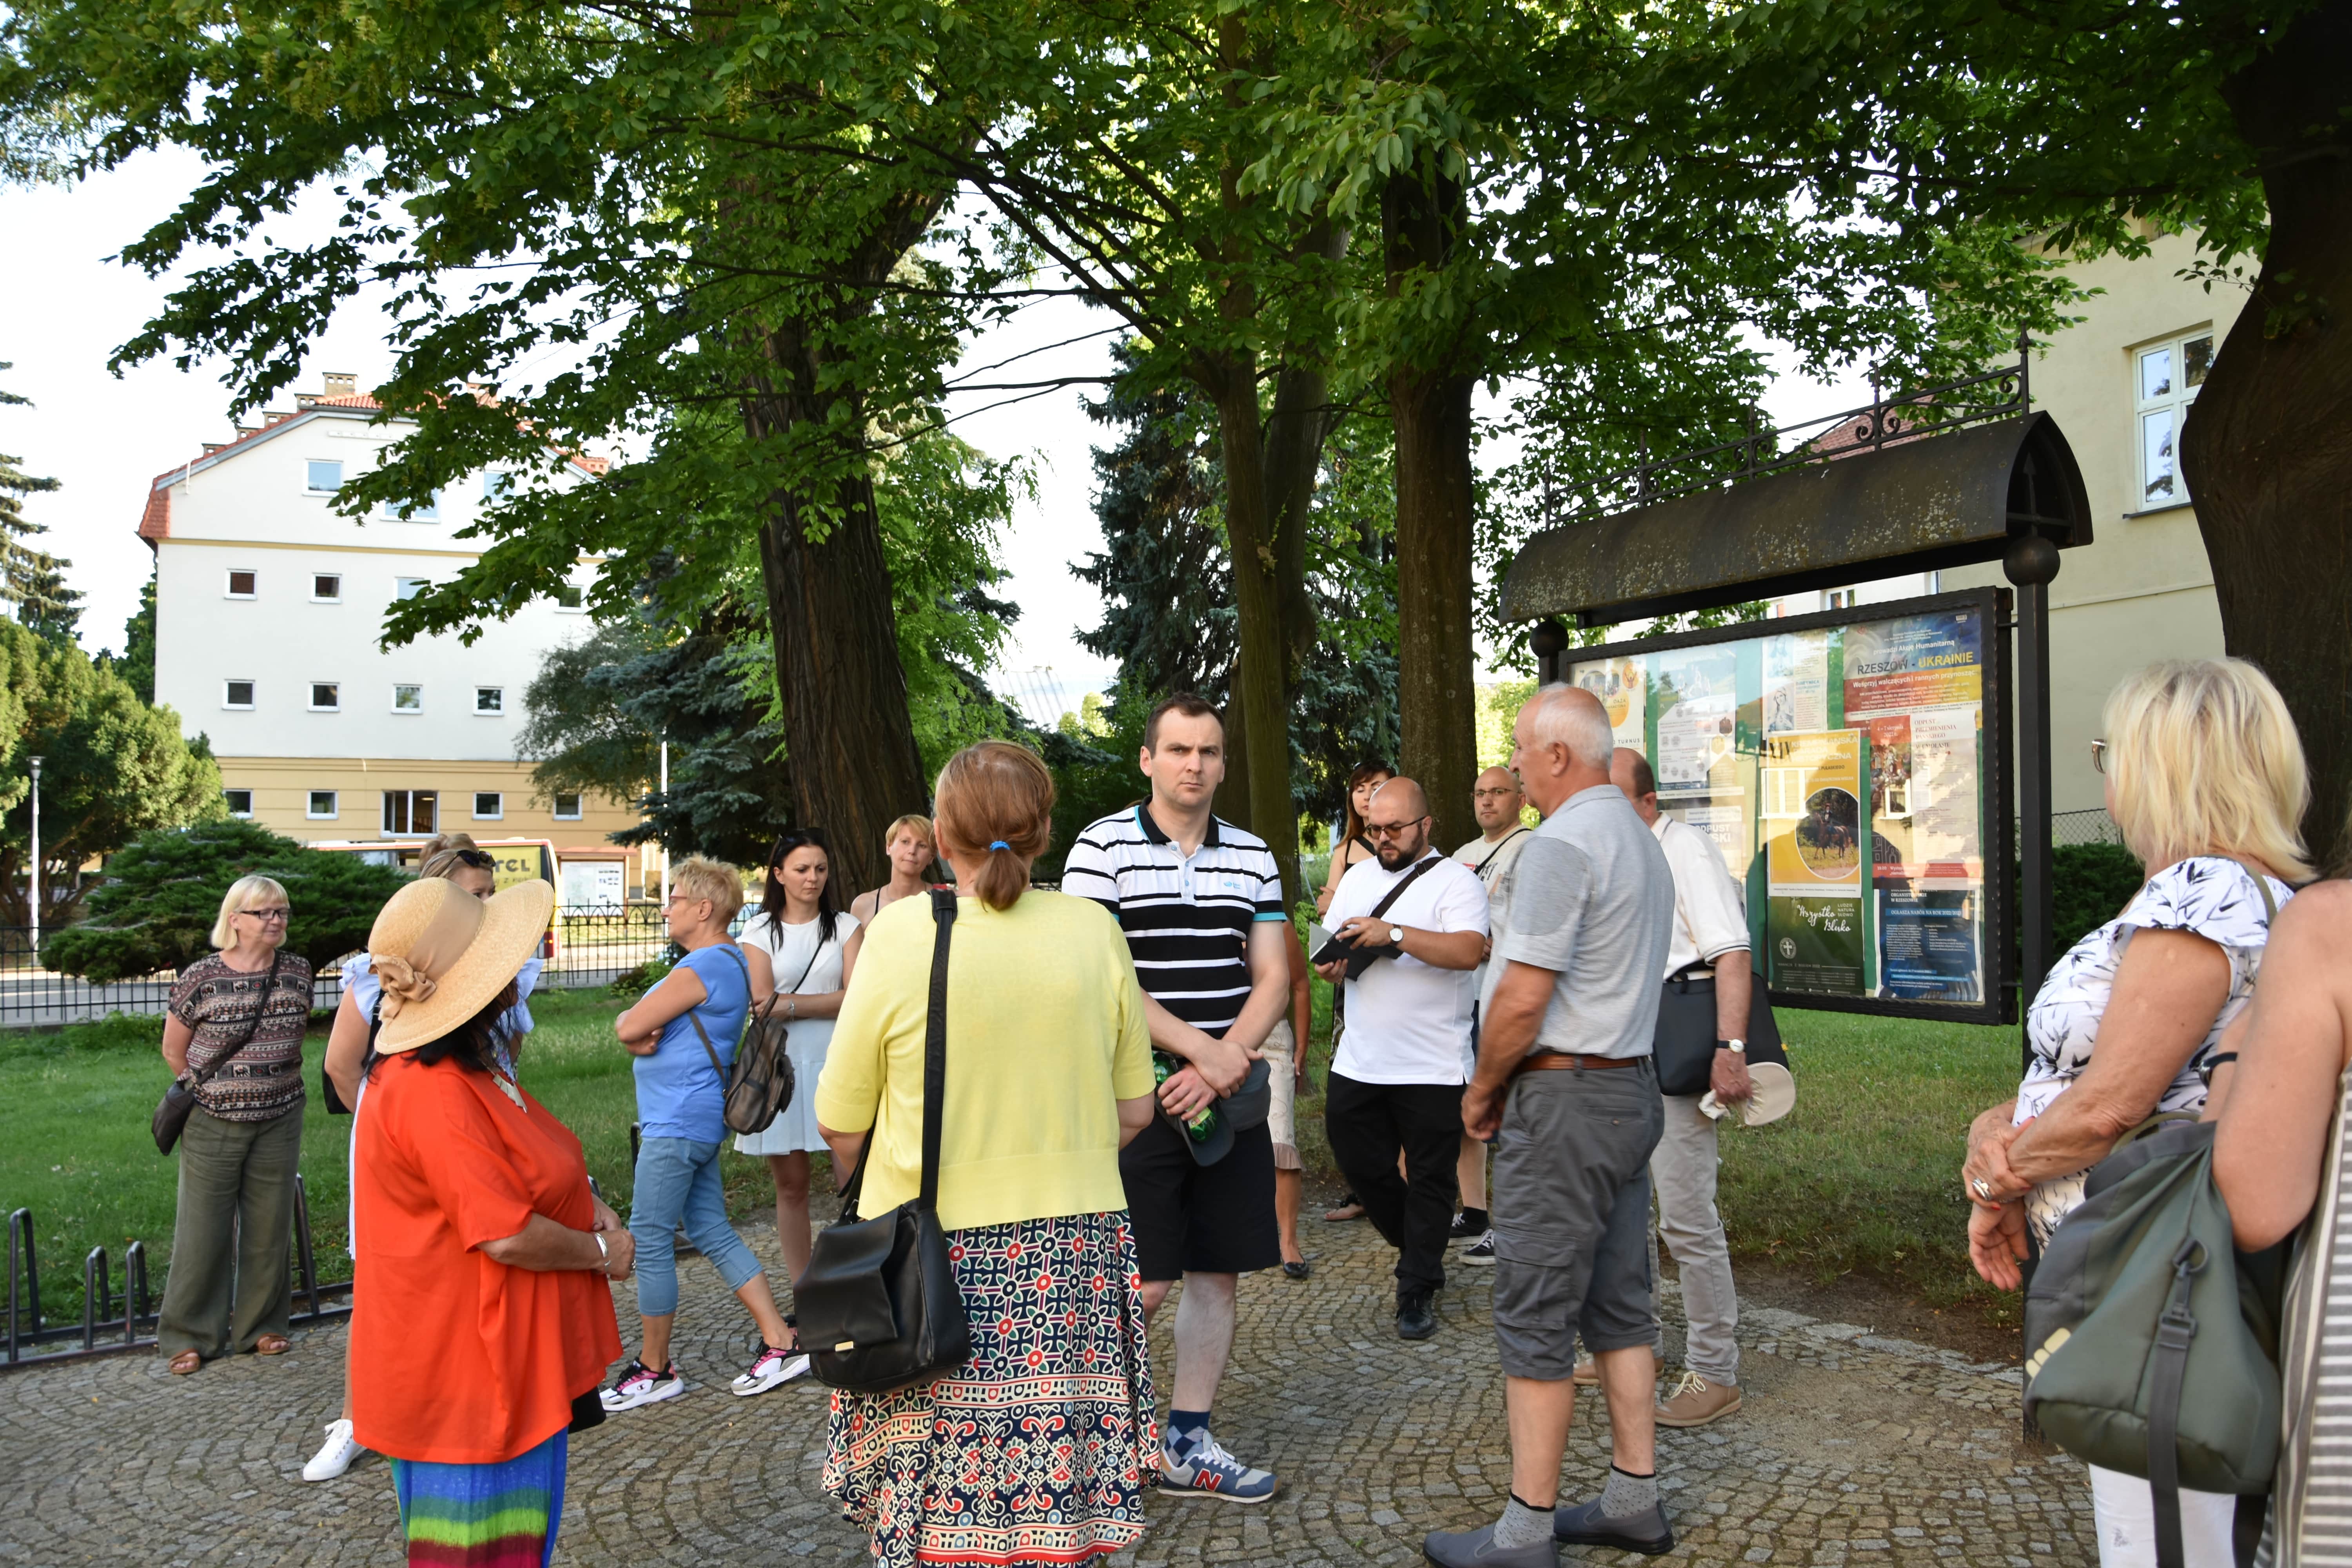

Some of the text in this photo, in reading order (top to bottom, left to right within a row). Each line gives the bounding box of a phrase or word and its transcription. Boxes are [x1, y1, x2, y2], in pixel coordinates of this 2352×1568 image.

[1873, 647, 1898, 655] prowadzi
[1916, 640, 1955, 649] Humanitarną
[1858, 659, 1908, 675] RZESZÓW
[1919, 652, 1973, 668] UKRAINIE
[1853, 679, 1877, 688] Wesprzyj
[1878, 676, 1910, 686] walczących
[1915, 673, 1939, 682] rannych
[1797, 904, 1836, 927] Wszystko
[1193, 1468, 1223, 1492] N
